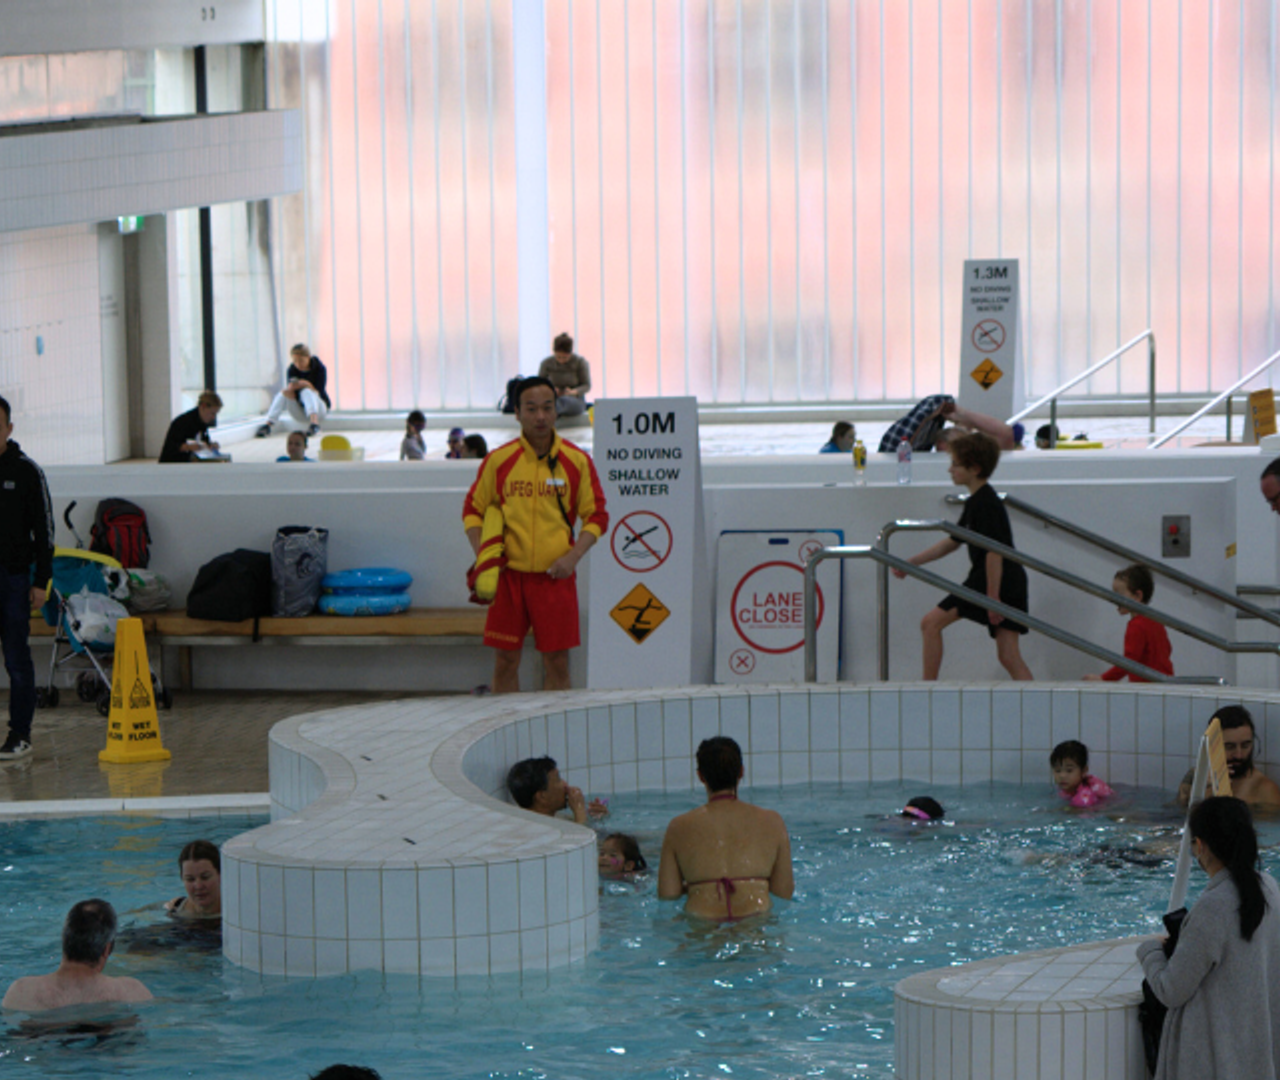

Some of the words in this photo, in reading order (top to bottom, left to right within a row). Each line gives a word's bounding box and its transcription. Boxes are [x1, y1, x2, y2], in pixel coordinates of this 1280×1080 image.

[973, 266, 1008, 279] 1.3M
[612, 411, 676, 435] 1.0M
[607, 448, 629, 460] NO
[633, 447, 682, 460] DIVING
[608, 468, 680, 481] SHALLOW
[618, 484, 669, 496] WATER
[753, 592, 803, 607] LANE
[738, 608, 803, 624] CLOSE
